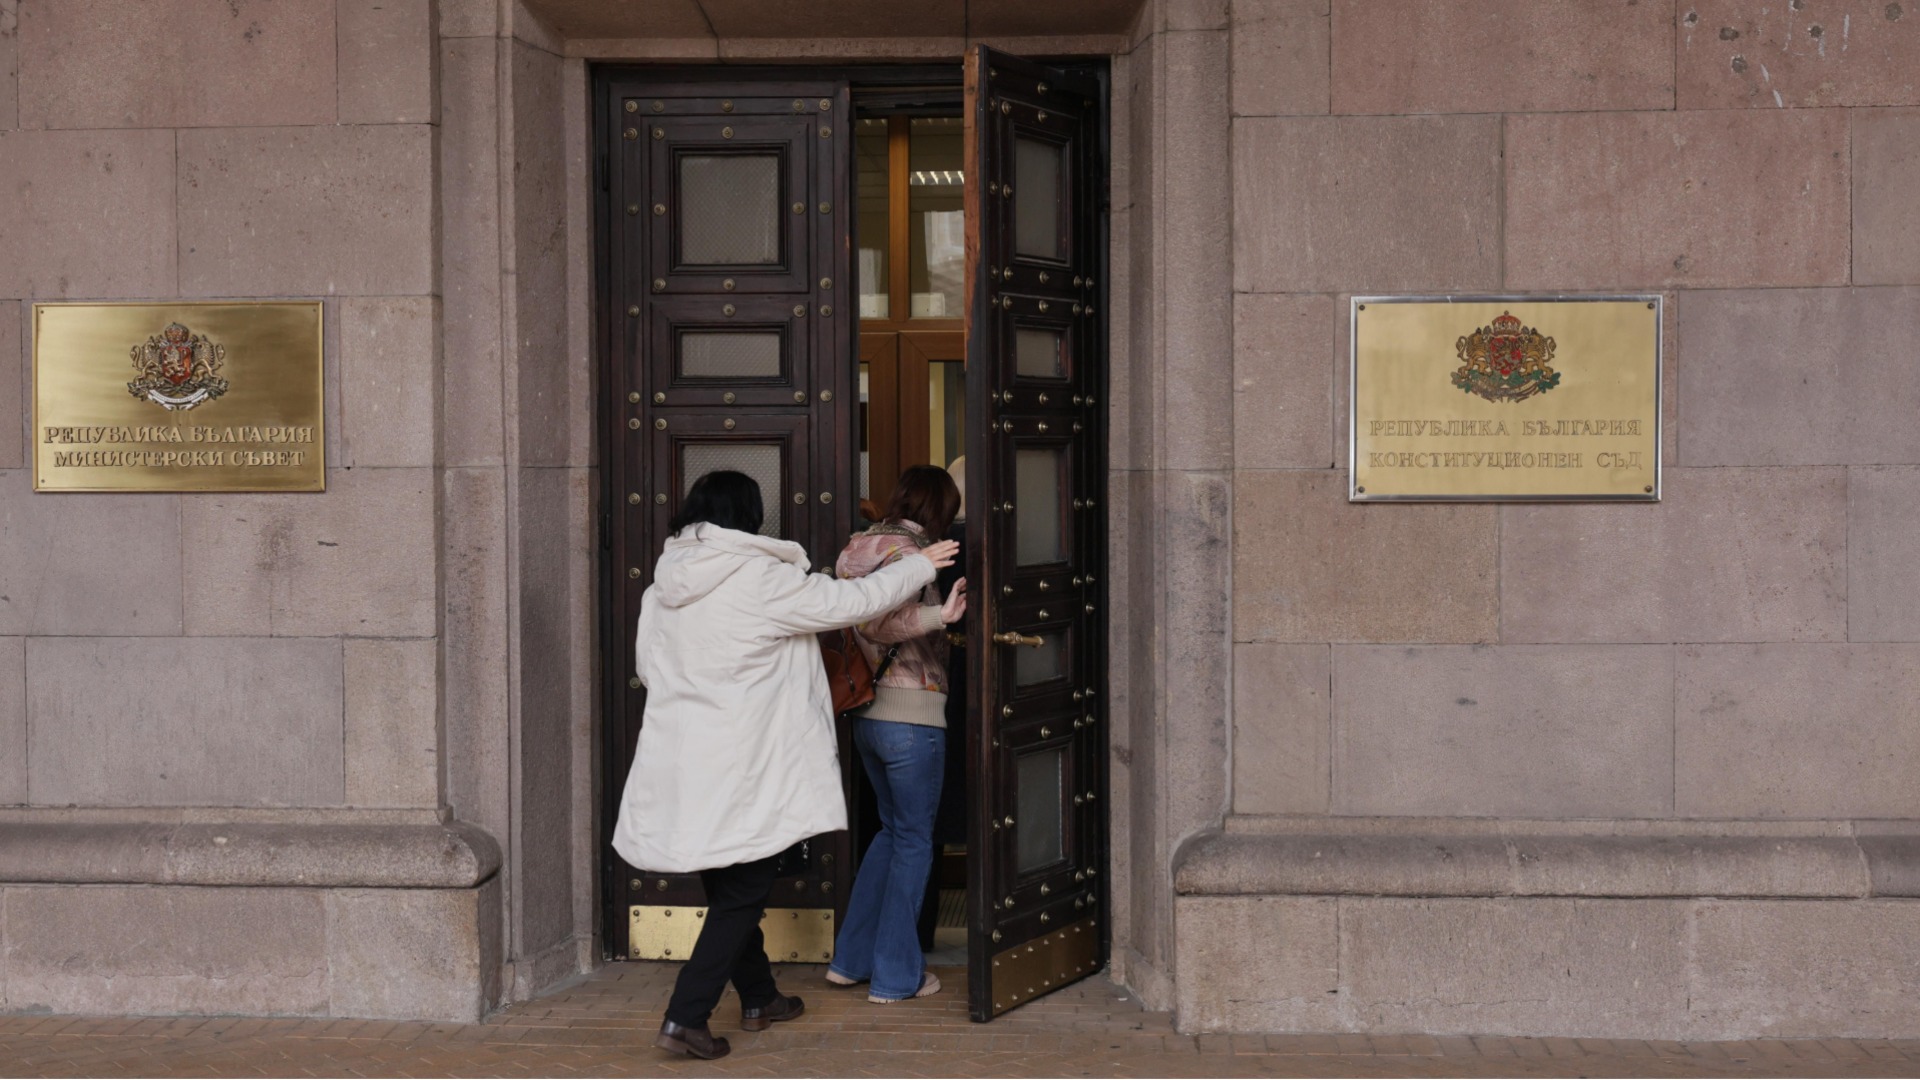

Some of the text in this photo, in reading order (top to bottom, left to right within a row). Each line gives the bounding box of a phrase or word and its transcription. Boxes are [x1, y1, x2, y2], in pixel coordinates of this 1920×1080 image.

[43, 426, 314, 444] РЕПУБЛИКА БЪЛГАРИЯ
[1369, 419, 1642, 437] РЕПУБЛИКА БЪЛГАРИЯ
[53, 451, 305, 468] МИНИСТЕРСКИ СЪВЕТ
[1369, 452, 1642, 470] КОНСТИТУЦИОНЕН СЪД
